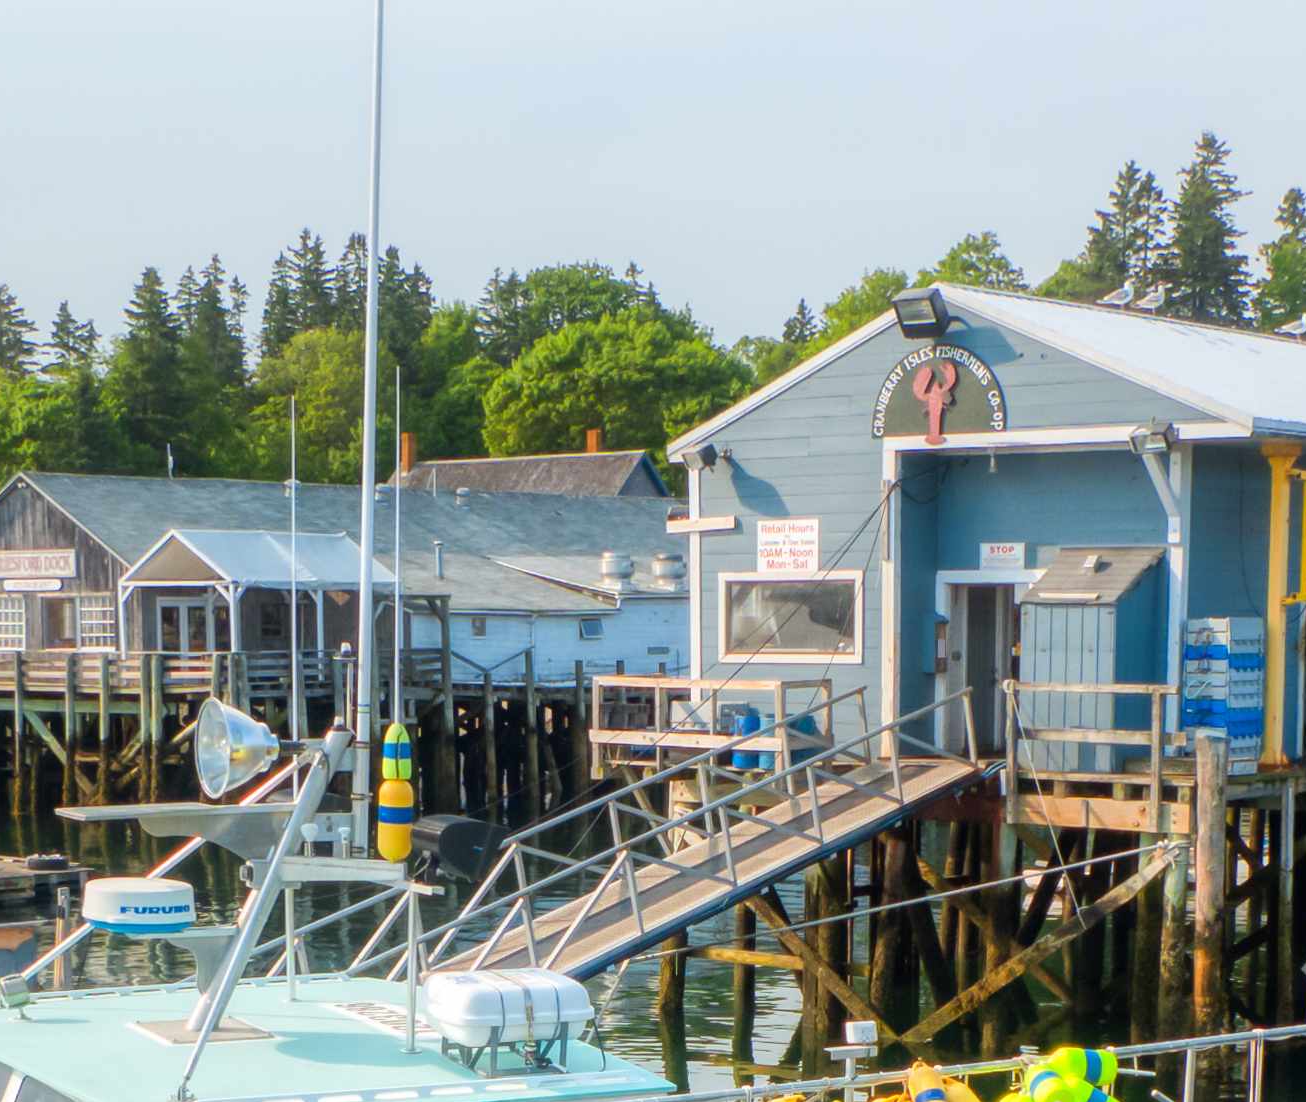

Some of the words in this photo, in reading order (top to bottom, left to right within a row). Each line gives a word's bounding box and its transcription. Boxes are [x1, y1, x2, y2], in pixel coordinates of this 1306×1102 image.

[873, 364, 905, 437] CRANBERRY
[903, 345, 934, 371] ISLES
[987, 390, 1004, 431] CO-OP
[761, 523, 786, 533] Retail
[789, 523, 815, 534] Hours
[989, 545, 1015, 554] STOP
[120, 904, 190, 914] FURUNO
